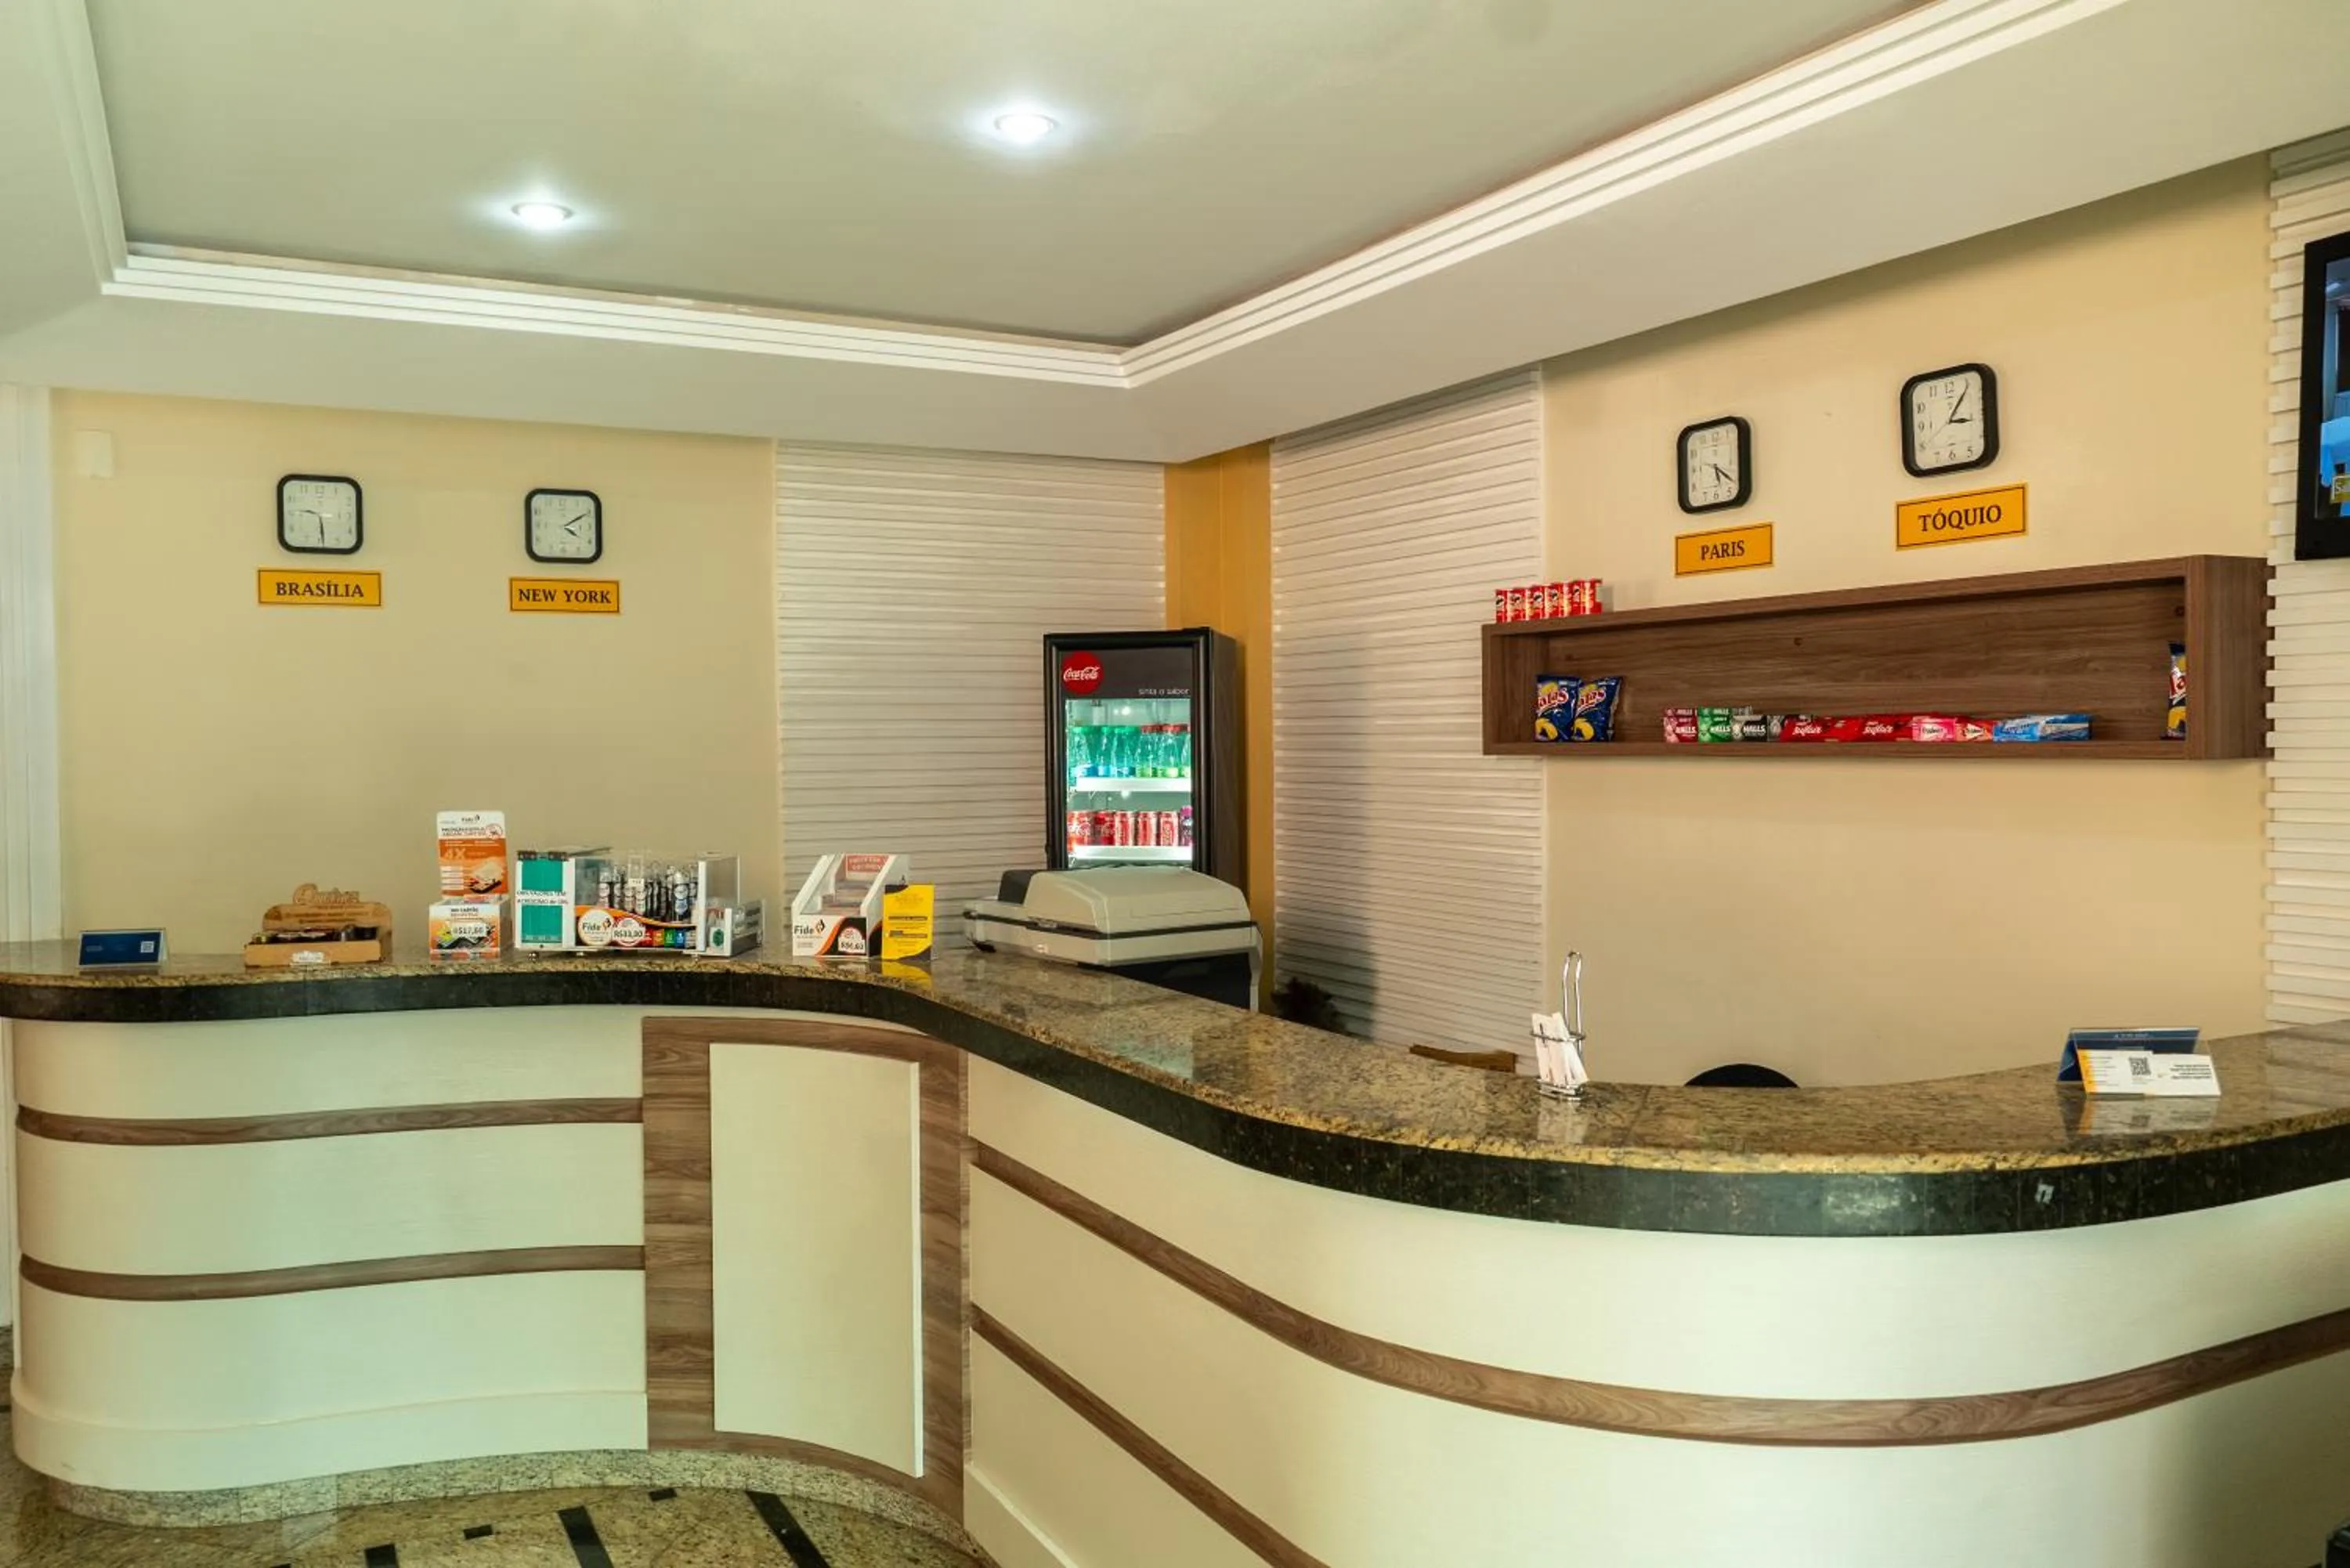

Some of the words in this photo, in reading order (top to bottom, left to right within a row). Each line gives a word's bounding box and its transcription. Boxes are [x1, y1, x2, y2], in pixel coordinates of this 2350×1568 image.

[1918, 505, 2001, 532] TÓQUIO
[1701, 540, 1745, 561] PARIS
[276, 580, 364, 598] BRASÍLIA
[518, 588, 557, 602] NEW
[564, 590, 612, 604] YORK
[1063, 666, 1101, 682] Coca-Cola
